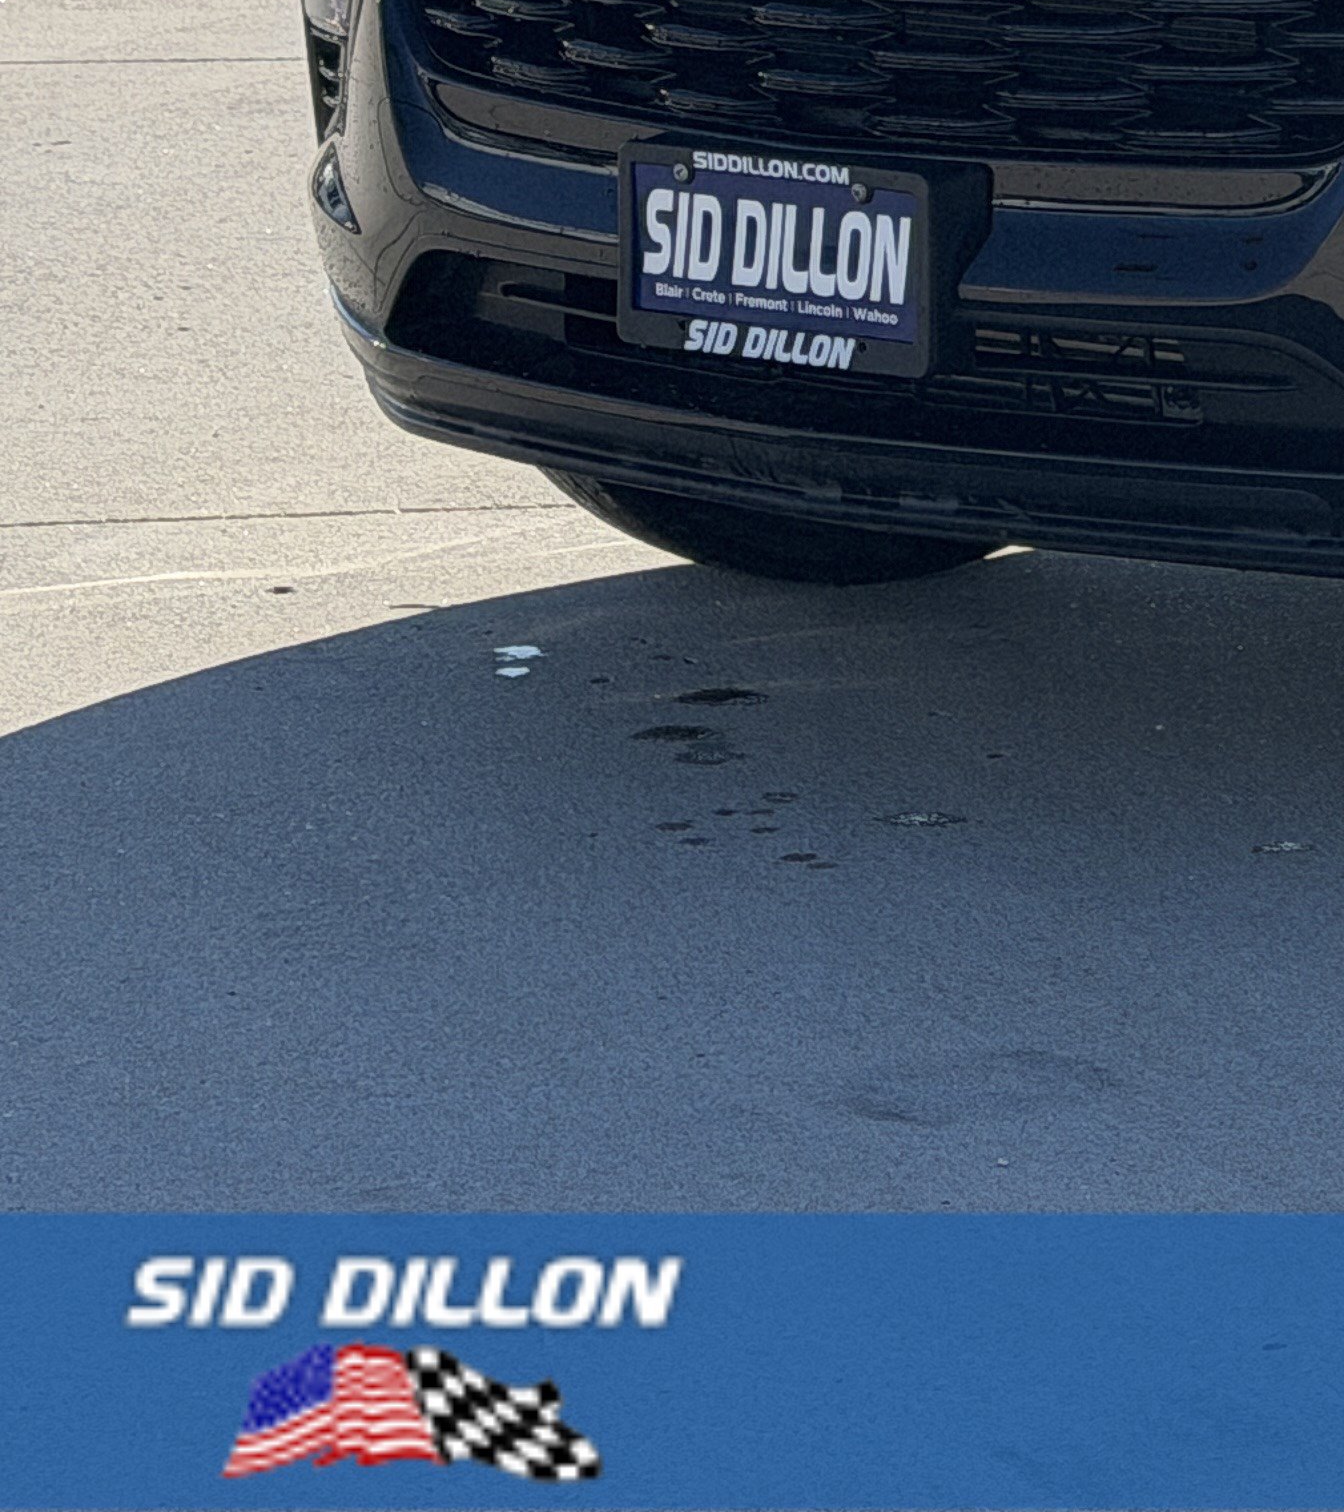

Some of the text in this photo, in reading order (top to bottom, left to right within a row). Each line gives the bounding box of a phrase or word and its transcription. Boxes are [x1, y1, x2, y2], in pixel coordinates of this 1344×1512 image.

[693, 150, 850, 186] SIDDILLON.COM
[642, 188, 912, 305] SID DILLON
[655, 282, 899, 326] Blair Crete Fremont Lincoln Wahoo
[684, 319, 857, 371] SID DILLON
